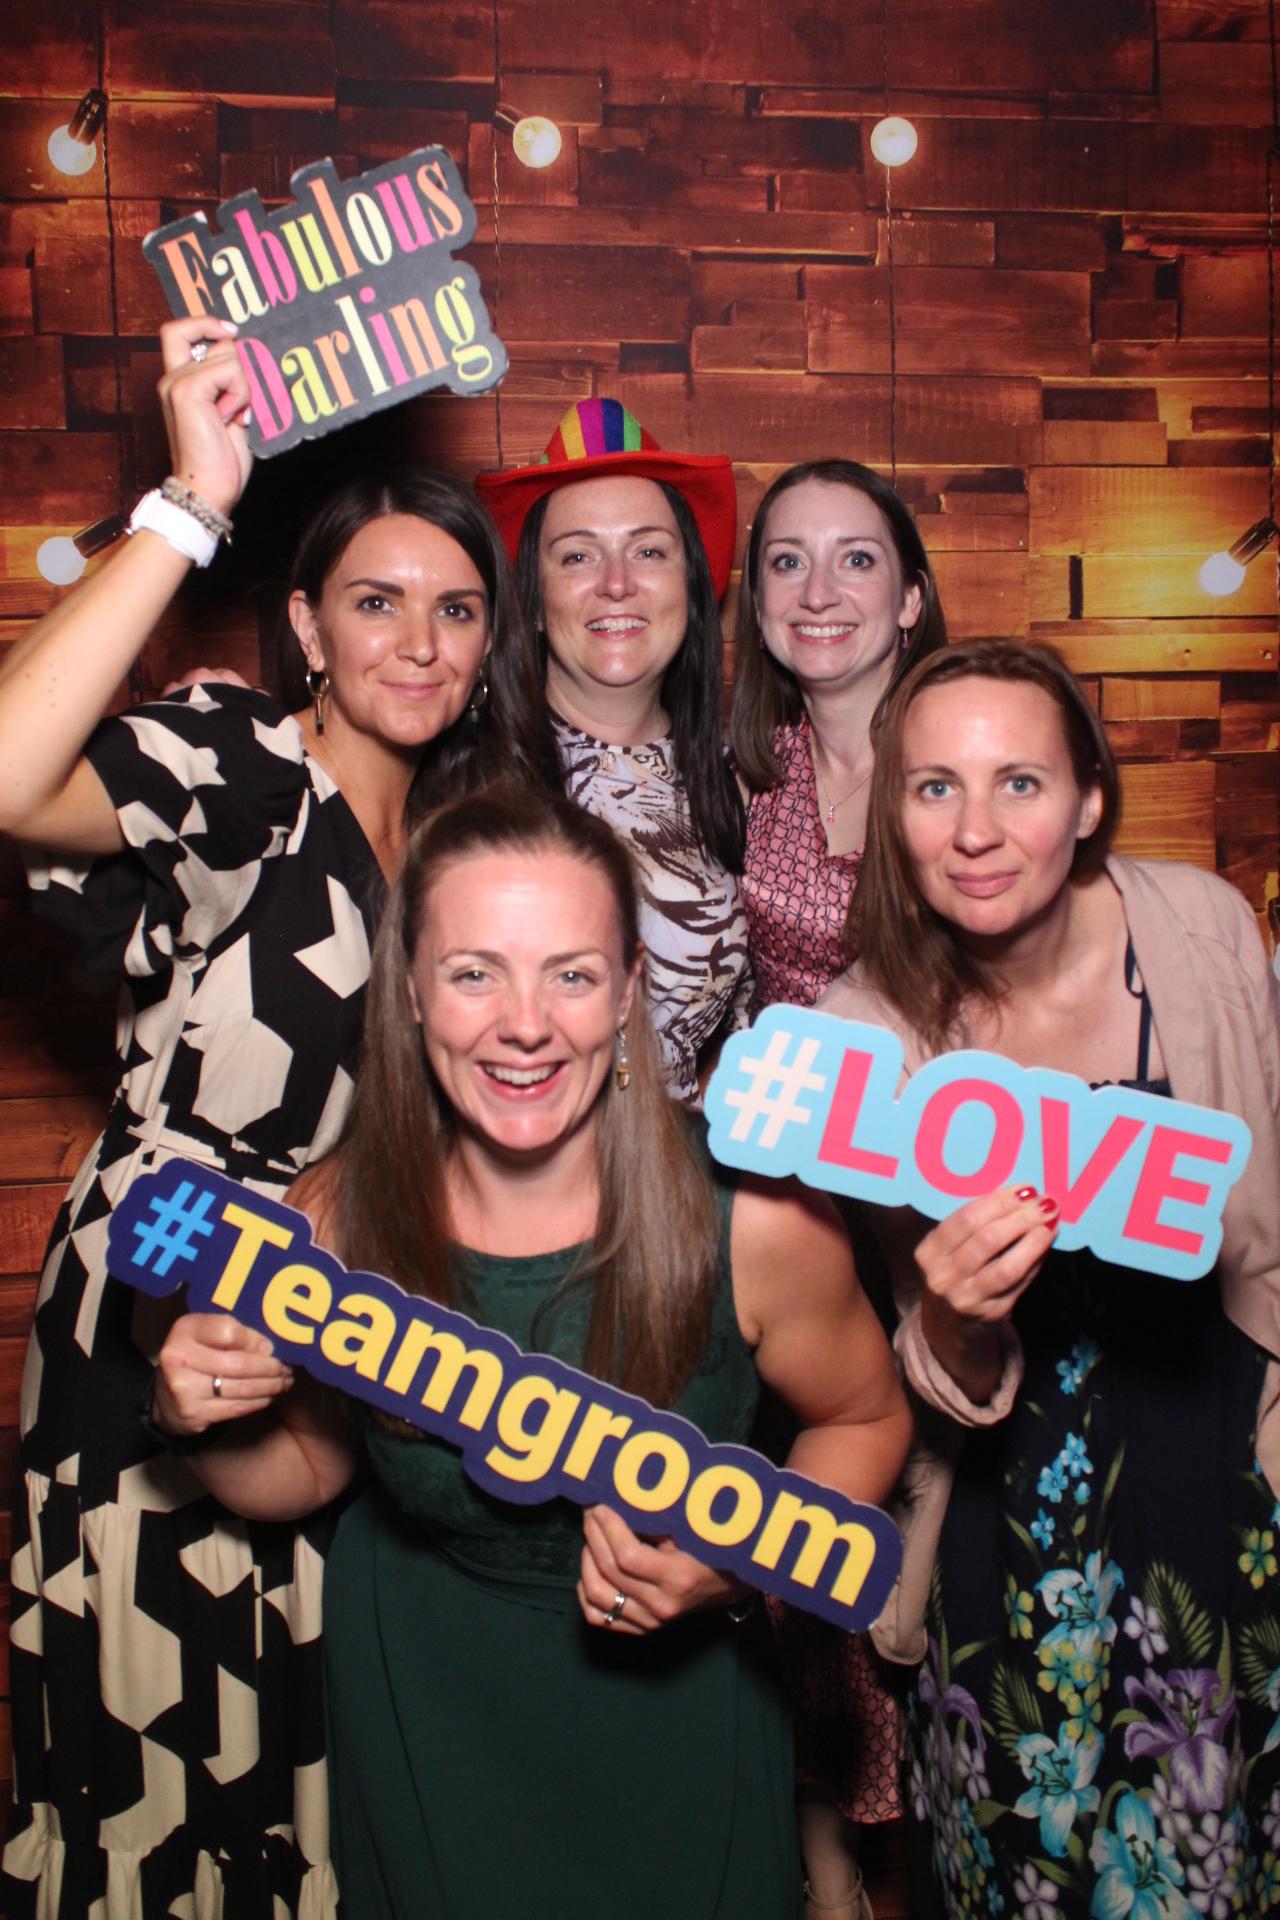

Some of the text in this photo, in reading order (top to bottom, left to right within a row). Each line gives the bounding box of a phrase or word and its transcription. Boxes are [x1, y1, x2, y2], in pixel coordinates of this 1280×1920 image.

[159, 162, 463, 324] Fabulous
[236, 277, 493, 443] Darling
[724, 1030, 1233, 1256] #LOVE
[130, 1180, 877, 1607] #Teamgroom
